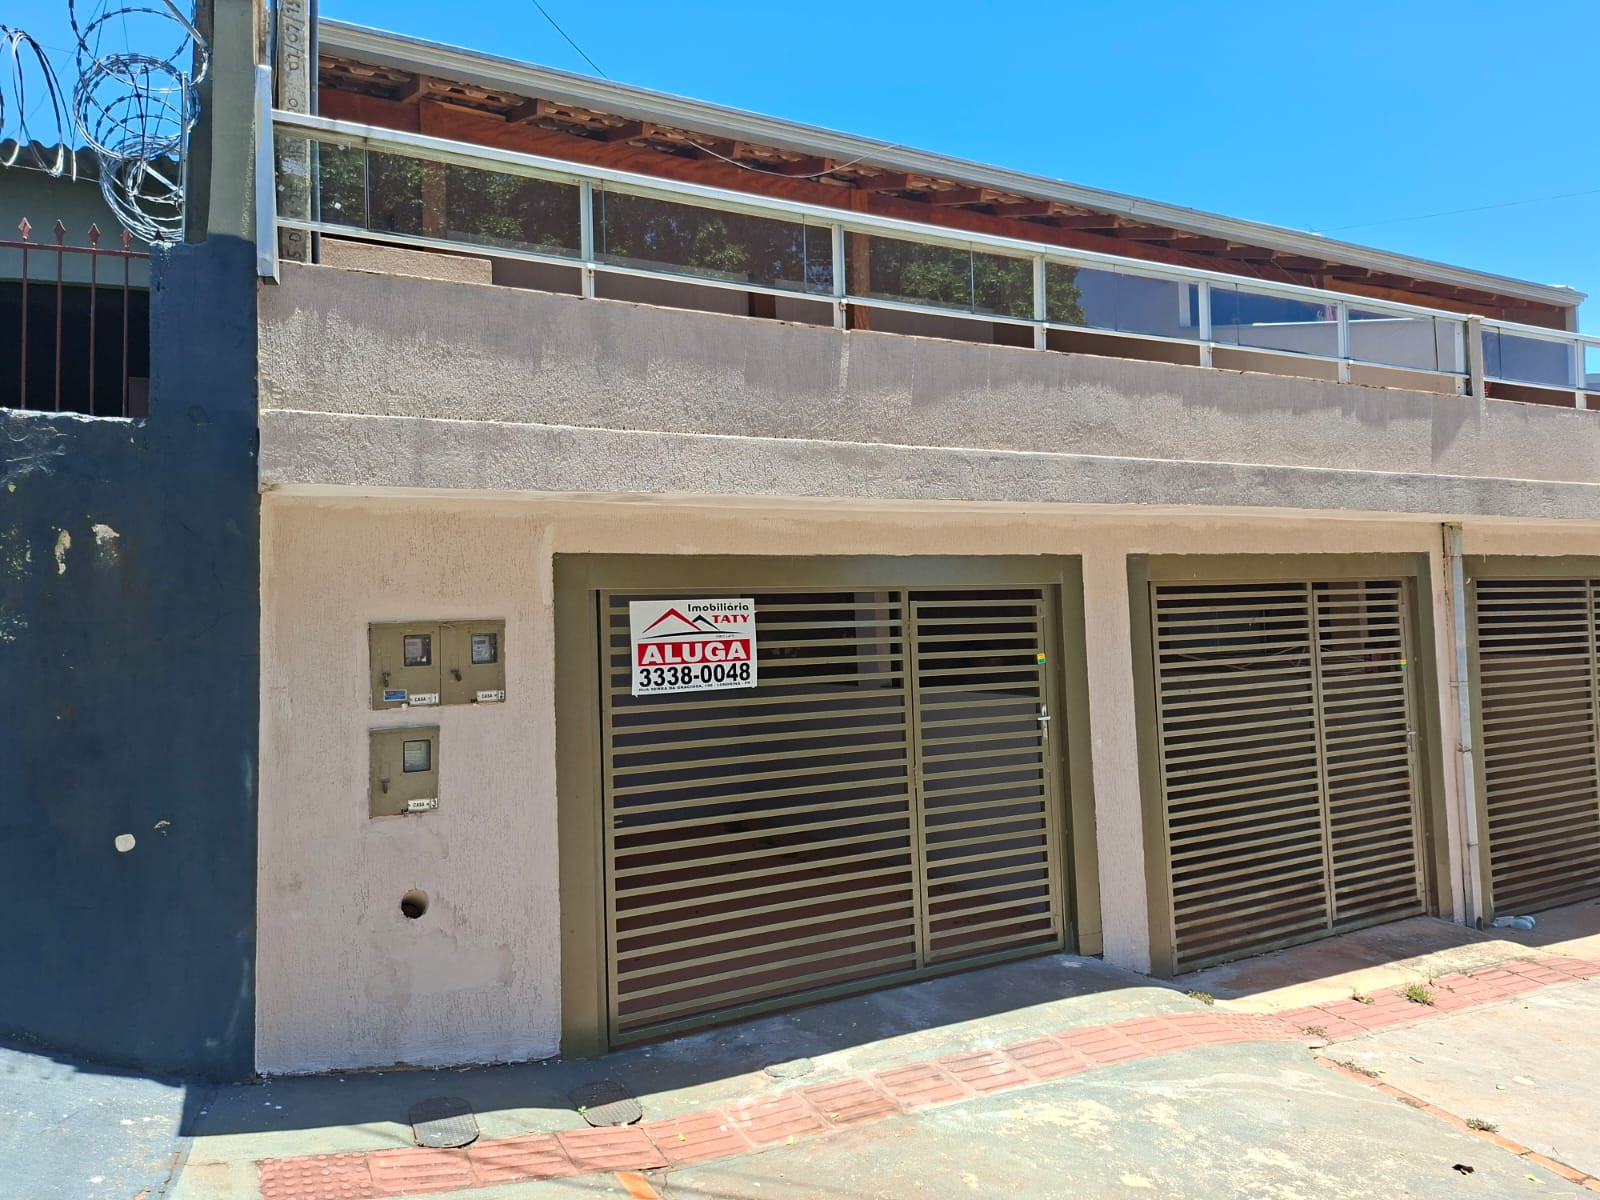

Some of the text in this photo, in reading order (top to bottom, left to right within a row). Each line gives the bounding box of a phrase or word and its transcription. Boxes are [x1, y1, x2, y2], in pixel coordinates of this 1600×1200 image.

[687, 602, 750, 613] Imobiliária
[711, 614, 750, 624] TATY
[641, 641, 748, 665] ALUGA
[639, 662, 751, 688] 3338-0048
